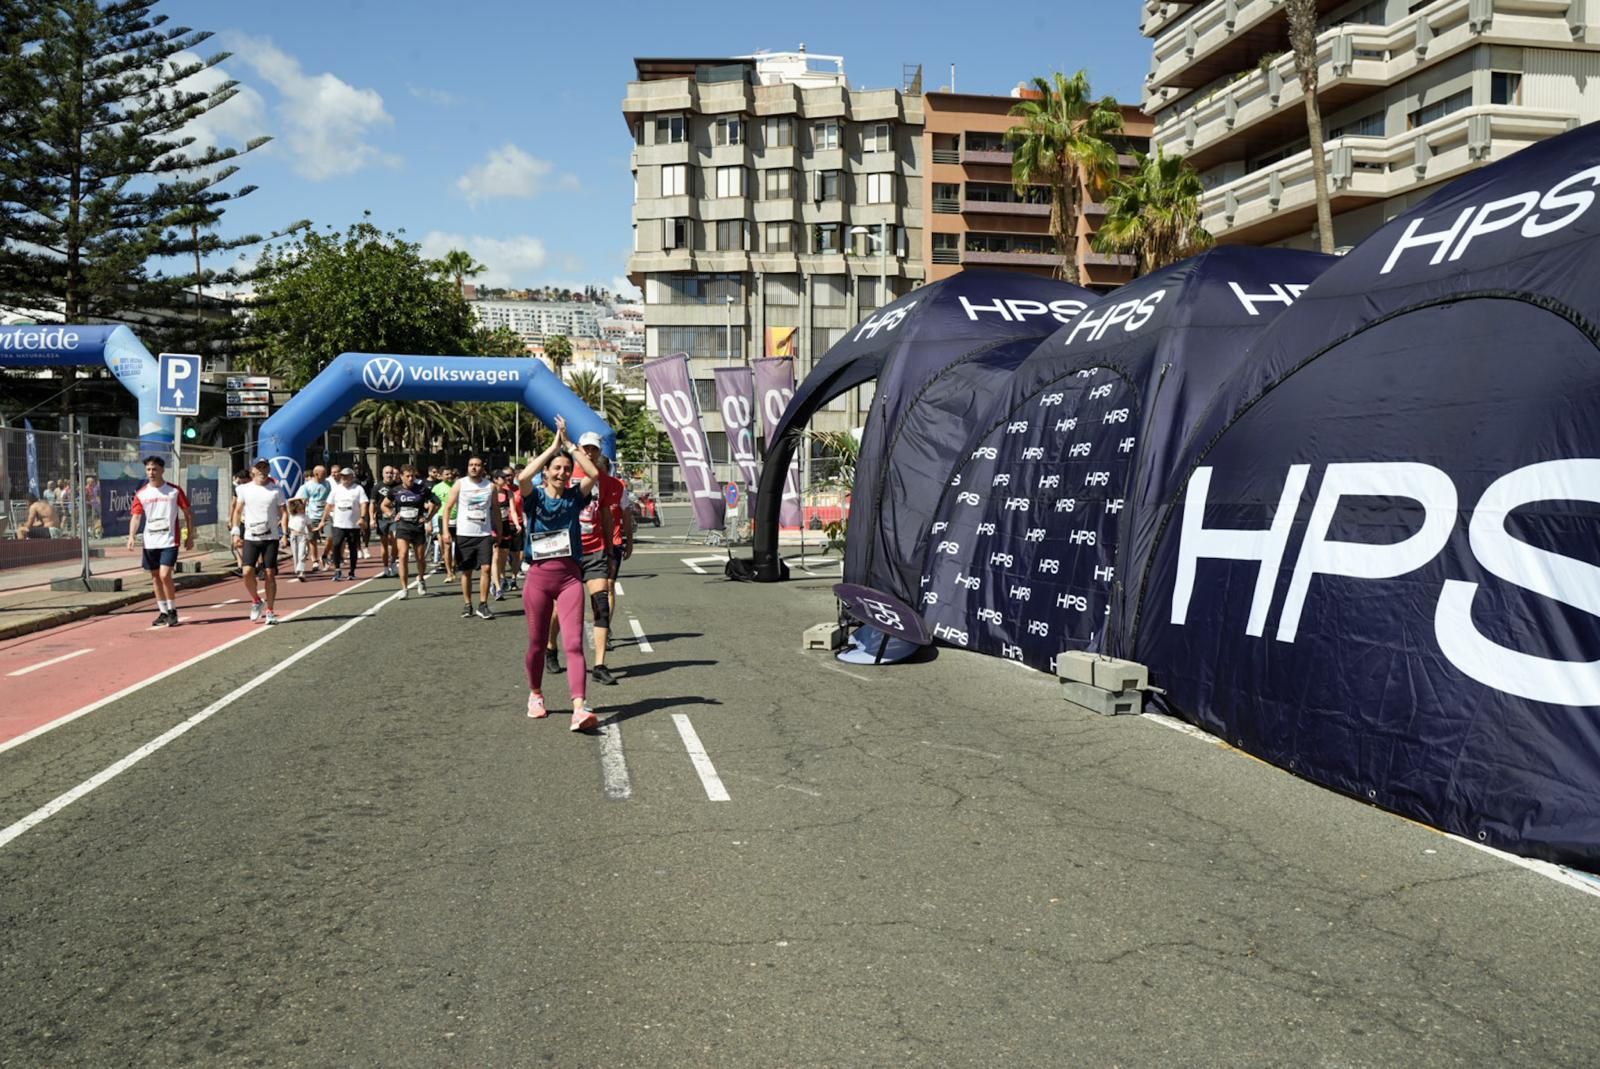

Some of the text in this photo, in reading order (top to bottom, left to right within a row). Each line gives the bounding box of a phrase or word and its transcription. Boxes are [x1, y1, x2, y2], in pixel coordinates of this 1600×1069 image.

[1379, 164, 1600, 275] HPS
[958, 296, 1088, 324] HPS
[1064, 289, 1167, 346] HPS
[853, 299, 917, 343] HPS
[167, 359, 192, 390] P
[410, 366, 520, 385] Volkswagen
[1040, 393, 1064, 407] HPS
[1089, 384, 1113, 400] HPS
[1055, 417, 1077, 432] HPS
[1102, 408, 1129, 425] HPS
[1006, 421, 1028, 434] HPS
[1068, 442, 1092, 457] HPS
[1118, 437, 1135, 453] HP
[1021, 447, 1044, 460] HPS
[1038, 475, 1060, 489] HPS
[1085, 472, 1110, 486] HPS
[956, 492, 980, 506] PS
[1005, 498, 1030, 512] HPS
[1055, 499, 1076, 513] HPS
[1105, 499, 1124, 514] HP
[976, 523, 996, 536] HPS
[1025, 528, 1046, 542] HPS
[1069, 530, 1096, 546] HPS
[936, 541, 959, 555] PS
[990, 552, 1014, 568] HPS
[1038, 559, 1060, 575] HPS
[955, 572, 980, 590] HPS
[1094, 565, 1114, 582] HP
[1170, 458, 1600, 707] HPS
[1009, 585, 1031, 601] HPS
[1056, 593, 1088, 612] HPS
[863, 598, 905, 631] HPS
[977, 608, 1003, 625] HPS
[933, 622, 969, 646] HPS
[1027, 619, 1049, 637] HPS
